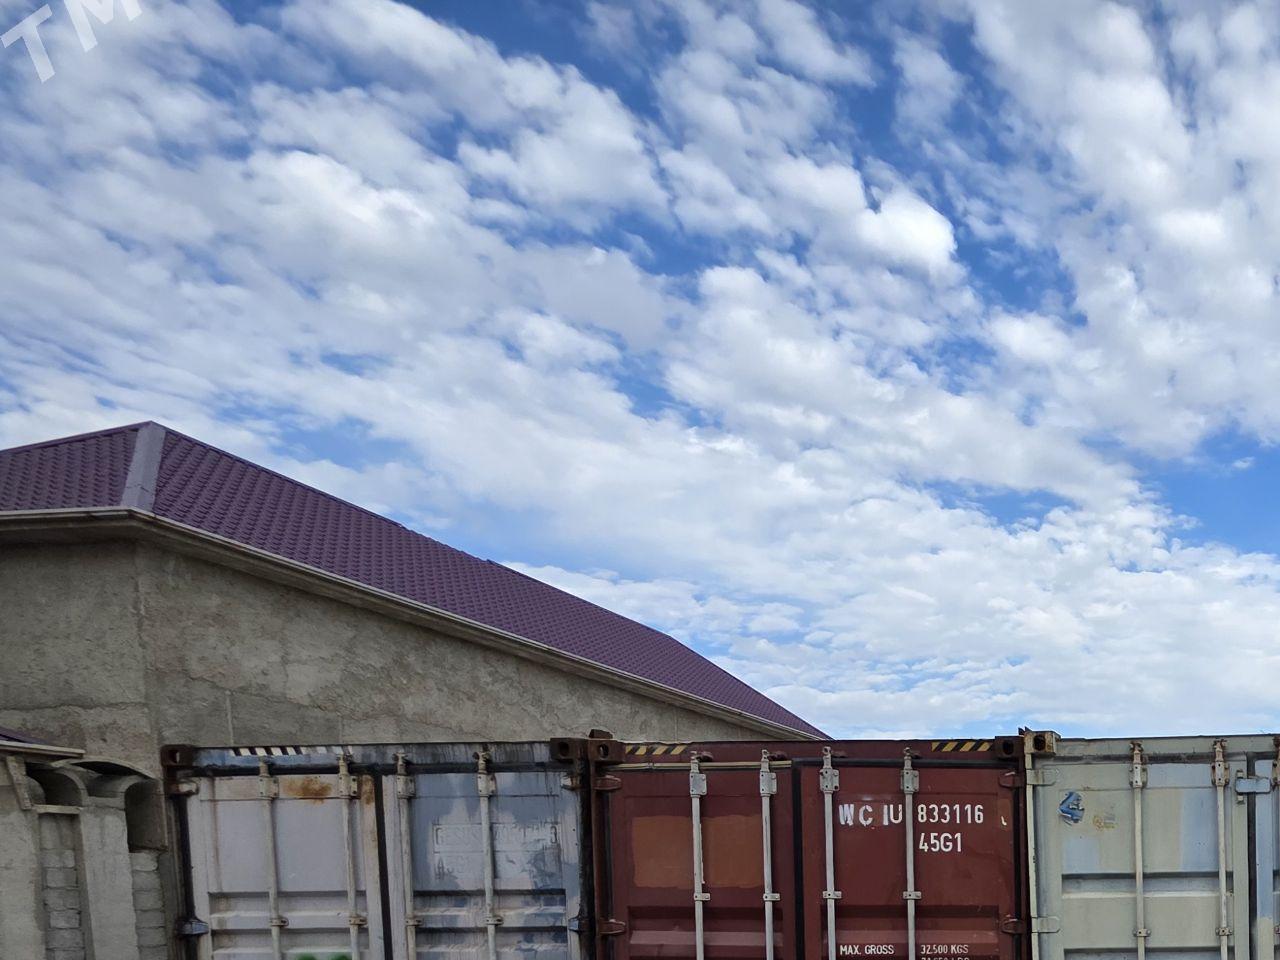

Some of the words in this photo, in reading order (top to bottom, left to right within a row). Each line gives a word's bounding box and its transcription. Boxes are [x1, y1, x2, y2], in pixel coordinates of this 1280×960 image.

[918, 804, 984, 824] 833116
[919, 832, 962, 852] 45G1
[840, 945, 861, 955] MAX.
[865, 944, 894, 954] GROSS
[951, 944, 969, 954] KGS
